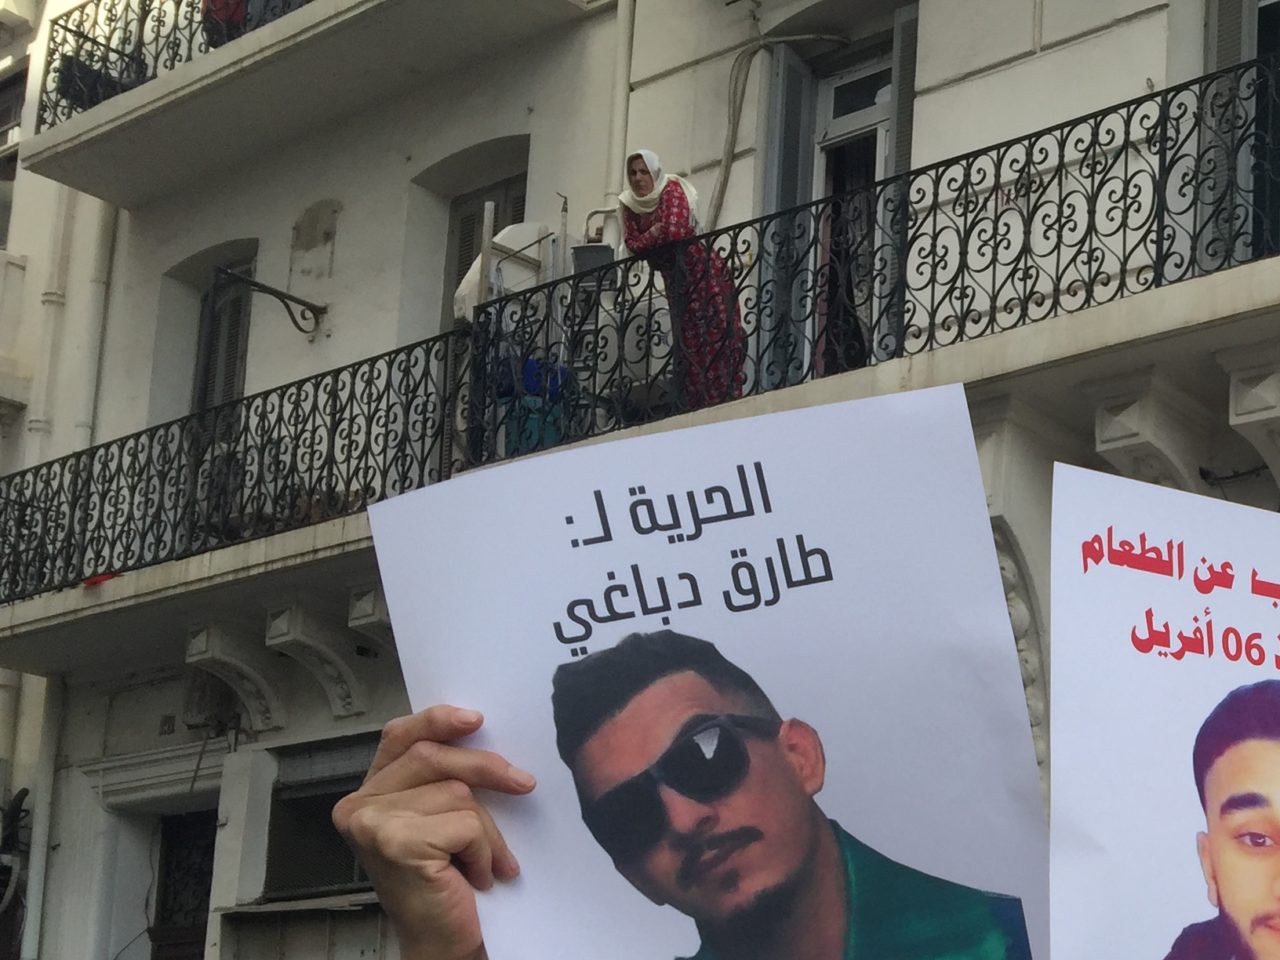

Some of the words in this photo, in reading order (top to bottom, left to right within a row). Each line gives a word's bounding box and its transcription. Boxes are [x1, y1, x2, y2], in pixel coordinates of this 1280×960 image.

[628, 461, 772, 545] الحرية
[722, 534, 834, 613] طارق
[1081, 526, 1185, 580] الطعام
[1193, 556, 1235, 595] عن
[552, 563, 703, 658] دباغي
[1130, 607, 1215, 661] أفريل
[1221, 626, 1266, 667] 06
